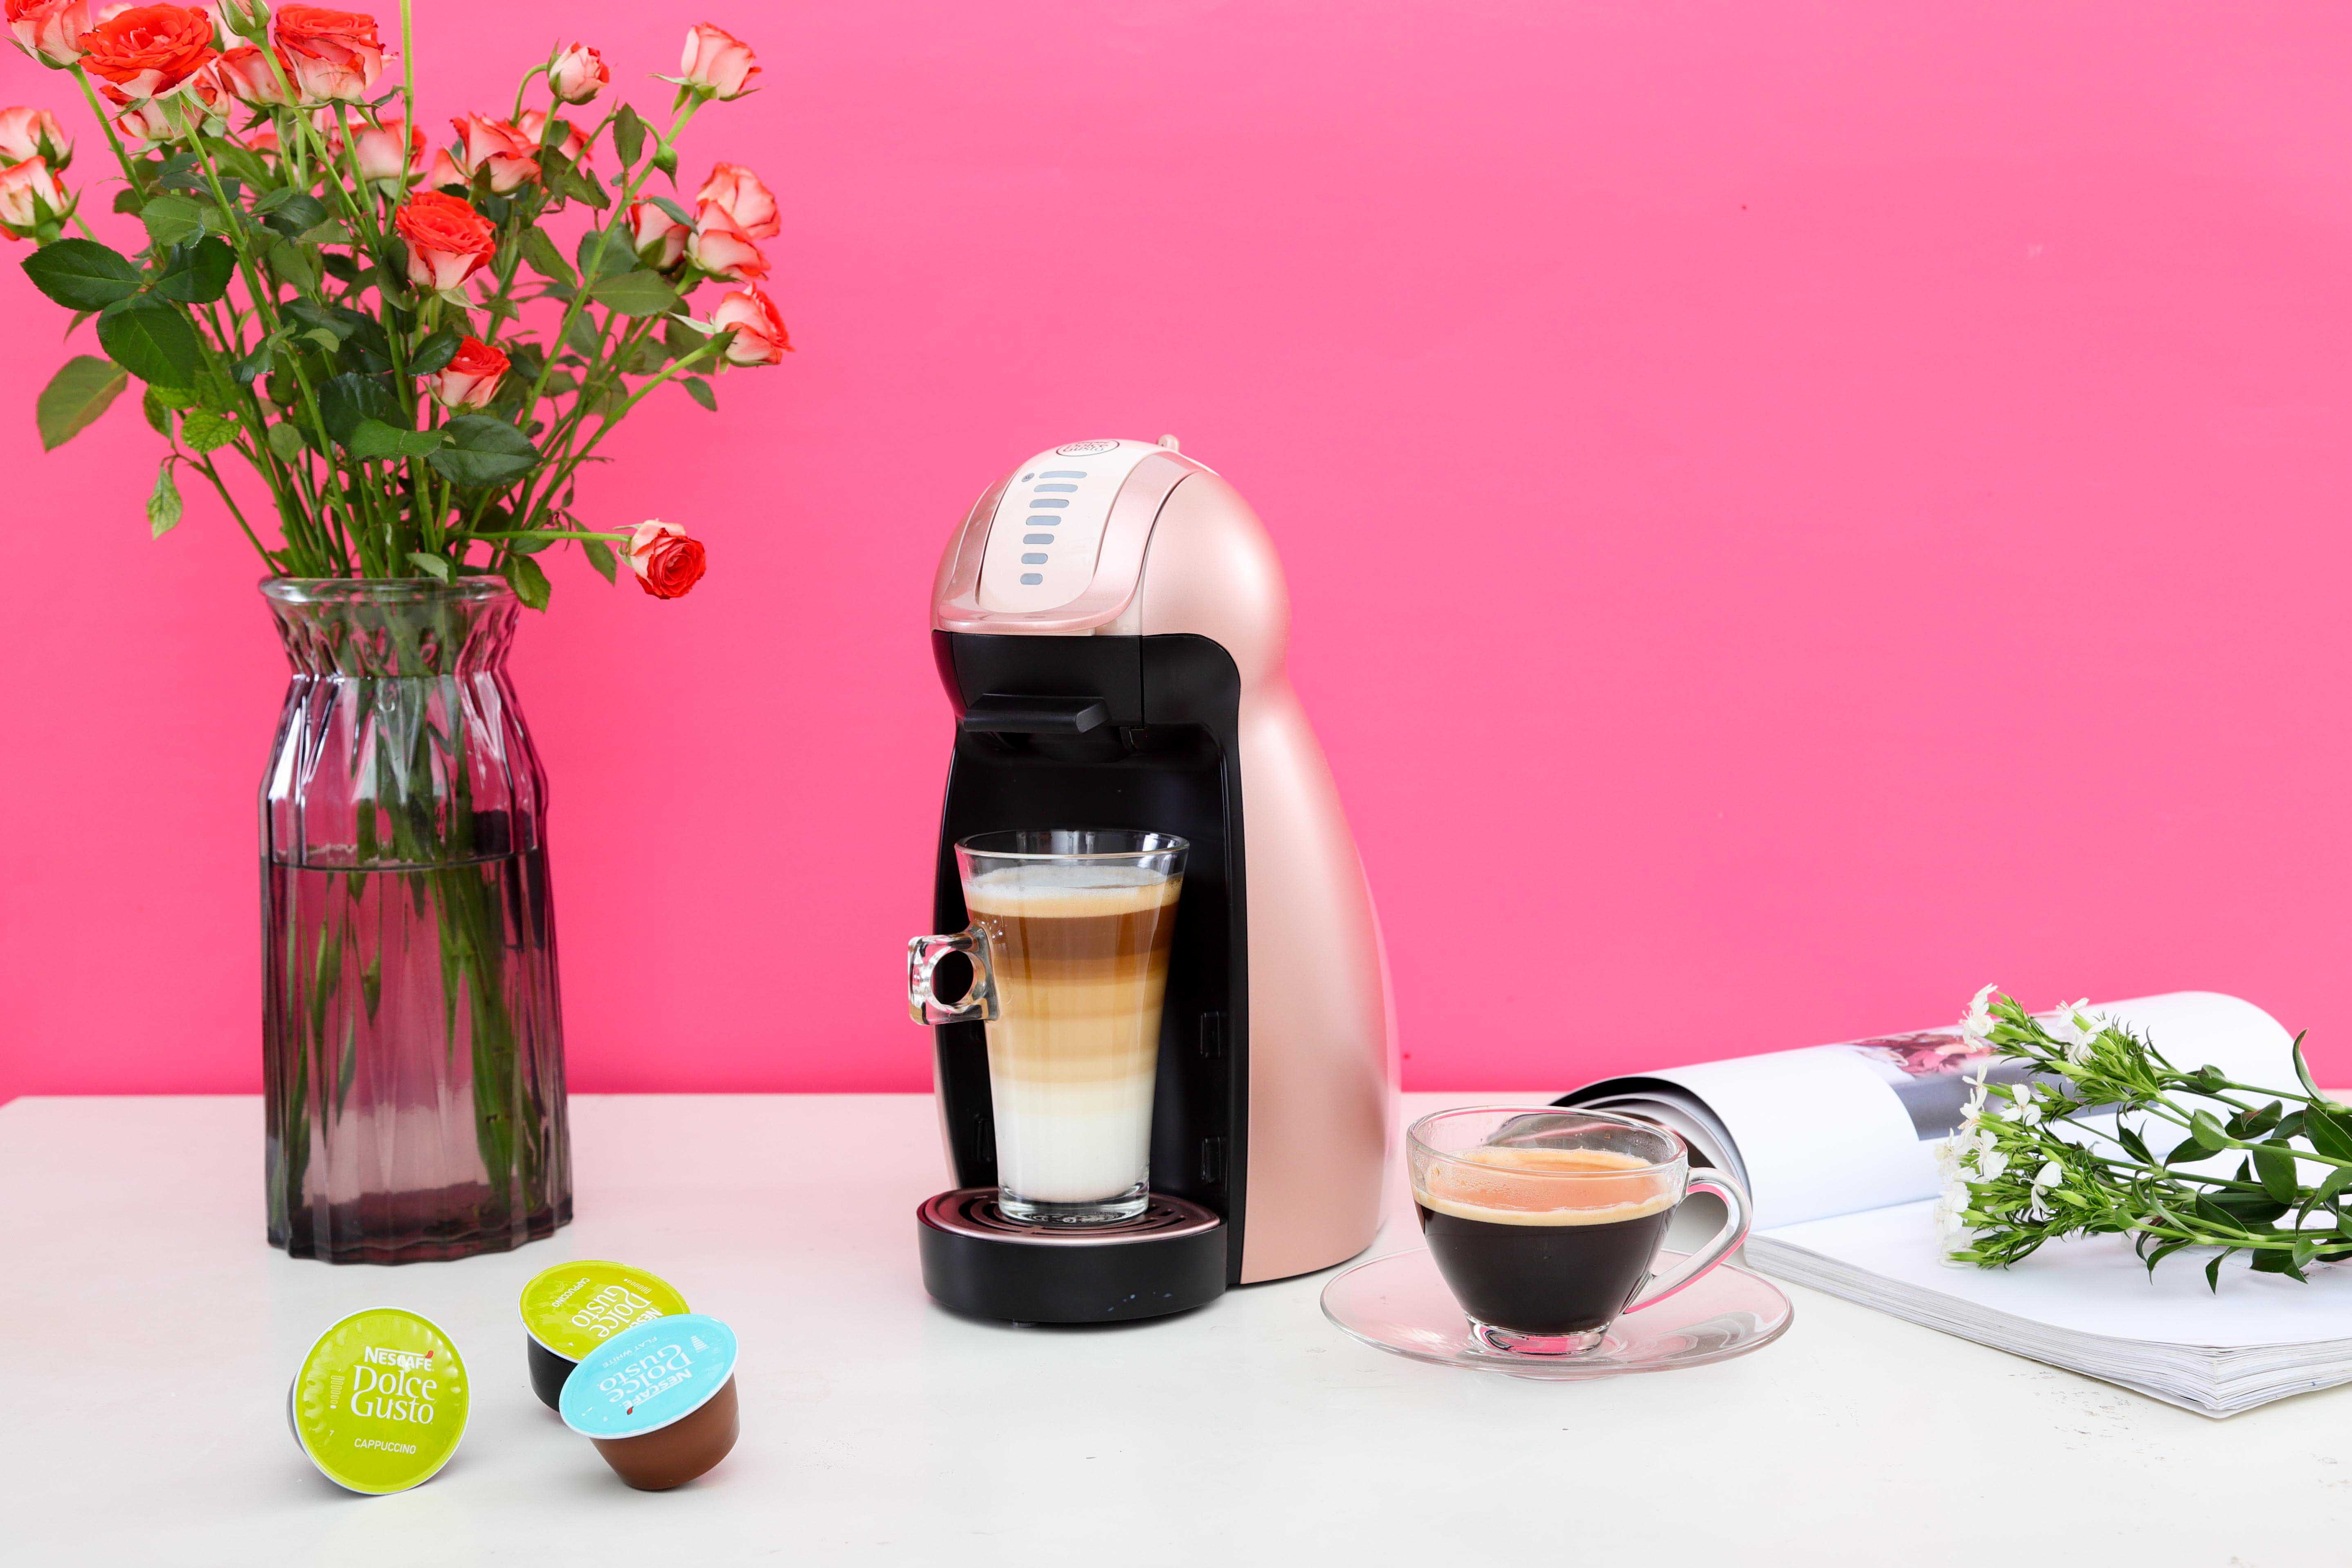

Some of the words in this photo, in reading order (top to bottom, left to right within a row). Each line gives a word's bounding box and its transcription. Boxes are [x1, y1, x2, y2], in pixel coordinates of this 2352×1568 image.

[552, 1278, 591, 1308] CAPPUCCINO
[571, 1285, 629, 1327] Gusto
[589, 1293, 652, 1337] Dolce
[602, 1349, 633, 1368] WHITE
[635, 1336, 658, 1352] FLAT
[353, 1365, 437, 1401] Dolce
[600, 1344, 681, 1391] Gusto
[605, 1352, 695, 1403] Dolce
[351, 1392, 434, 1424] Gusto
[354, 1438, 416, 1454] CAPPUCCINO
